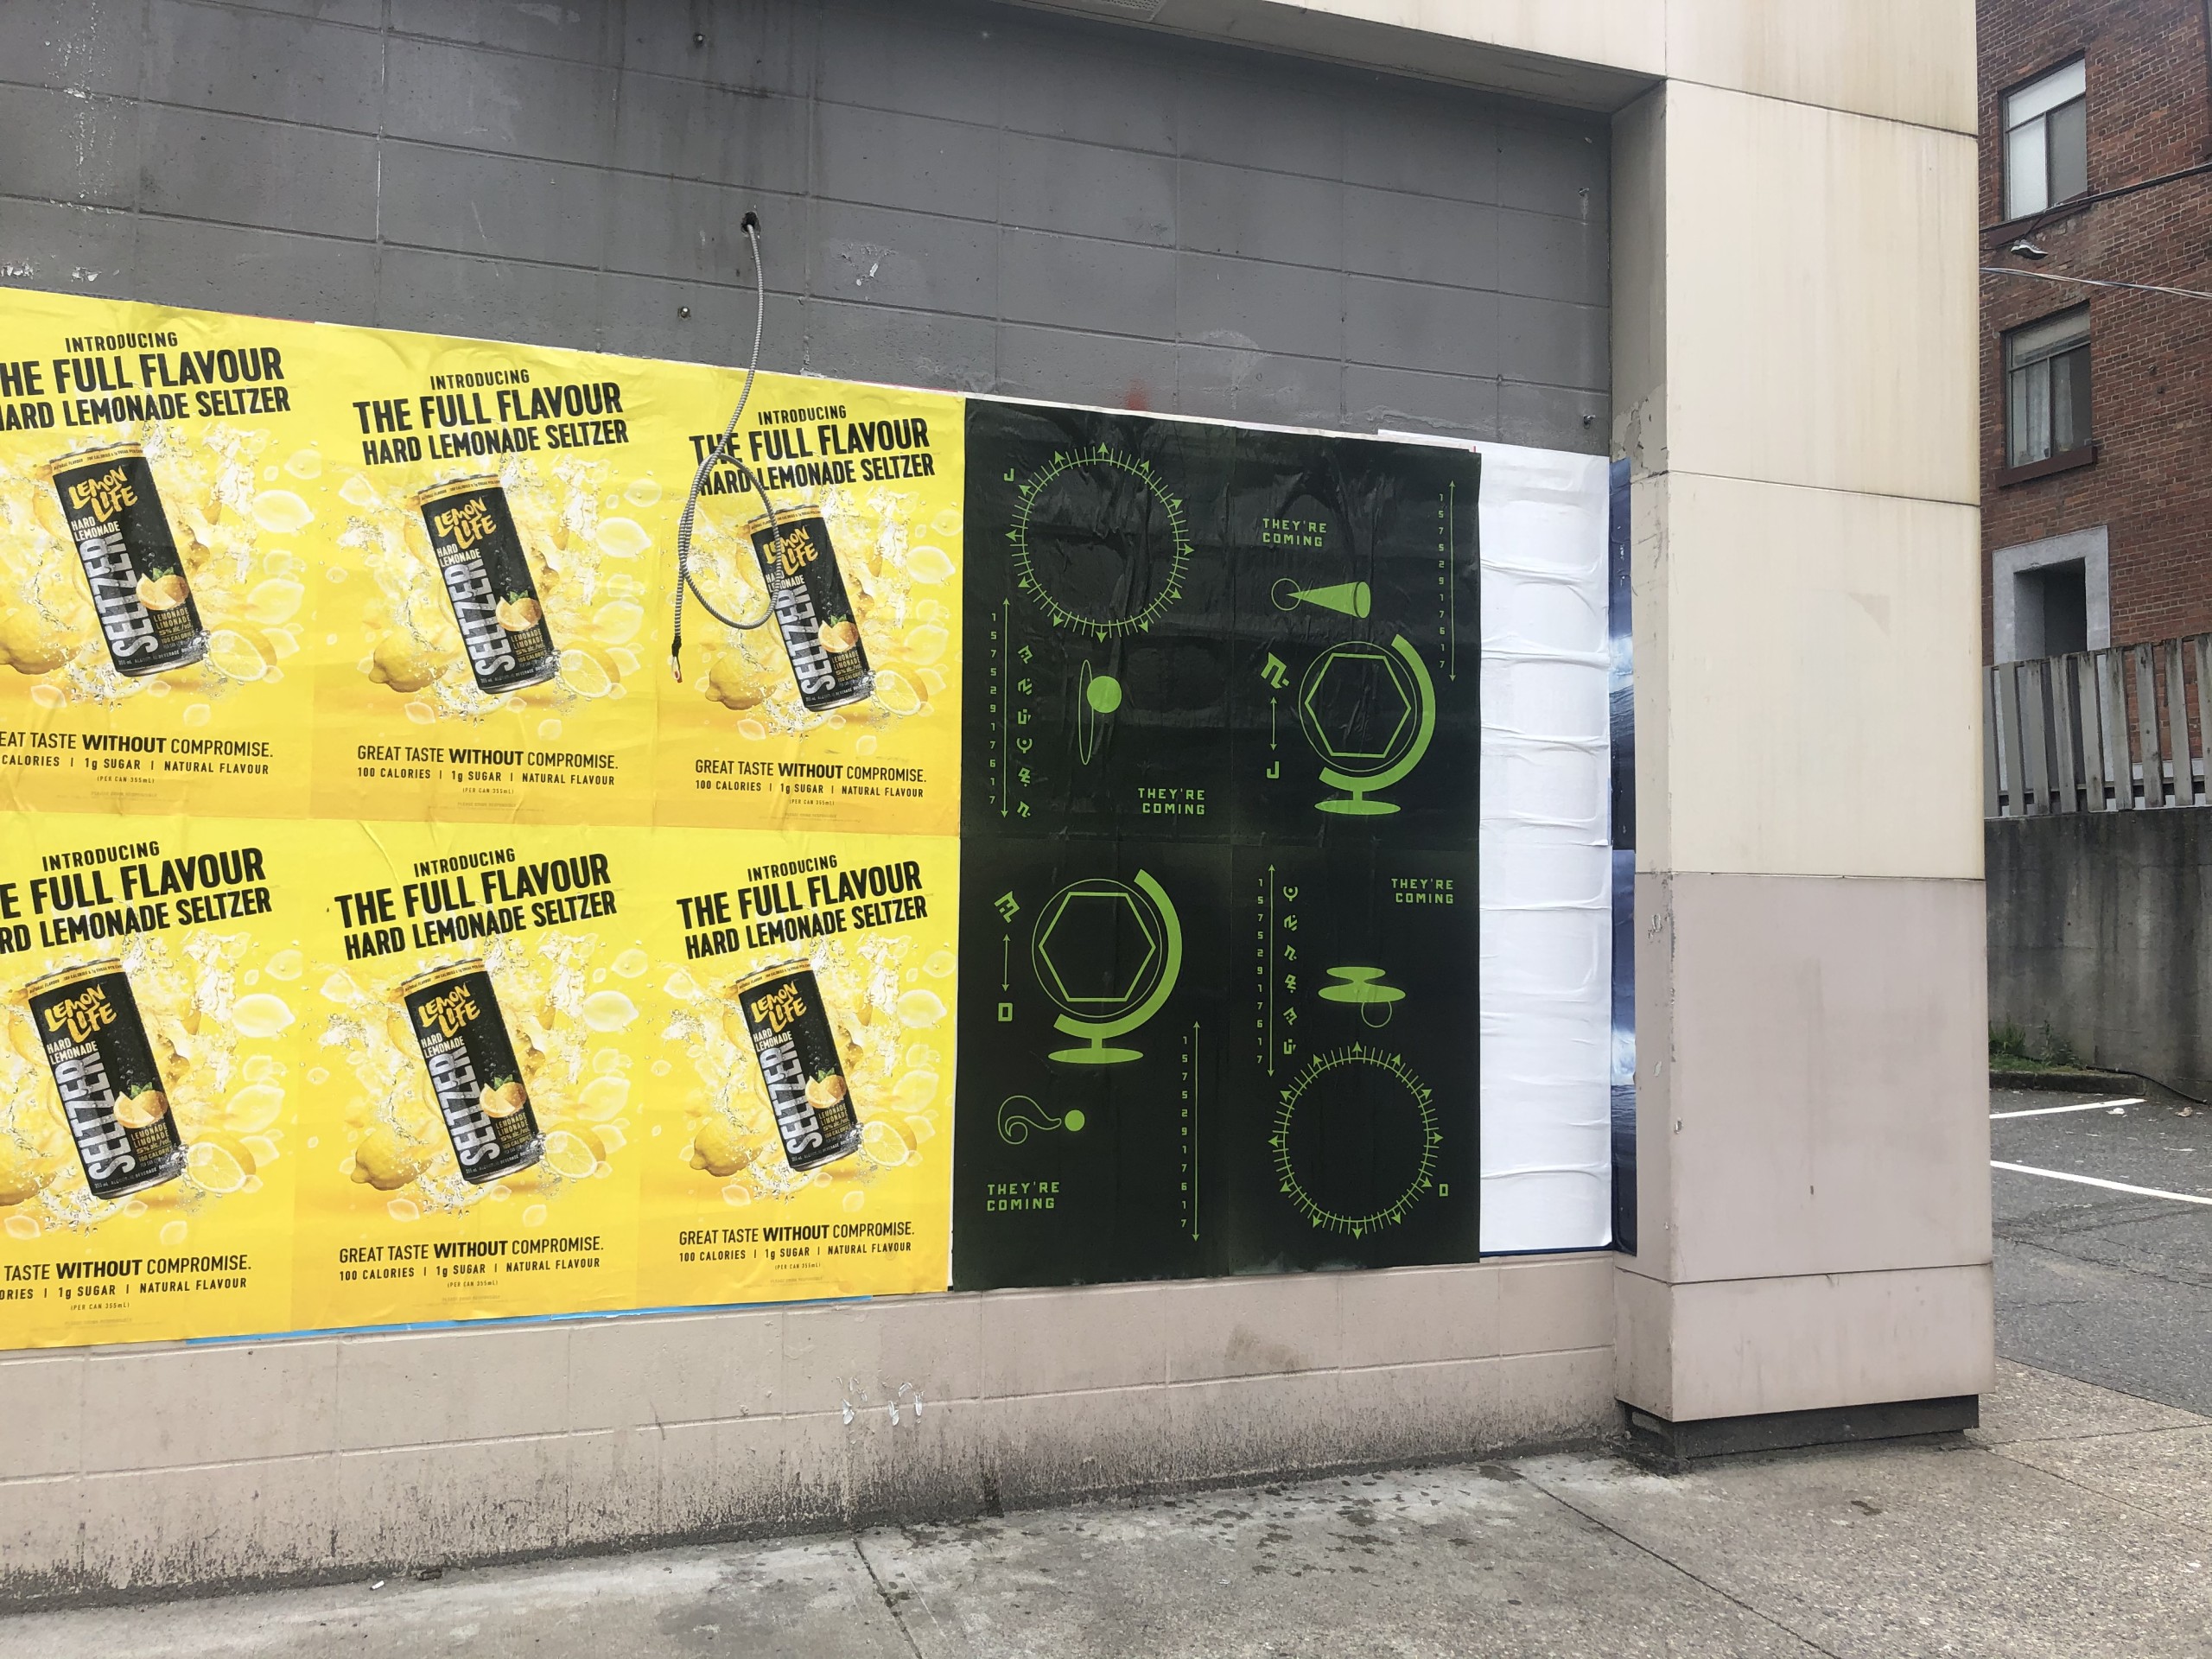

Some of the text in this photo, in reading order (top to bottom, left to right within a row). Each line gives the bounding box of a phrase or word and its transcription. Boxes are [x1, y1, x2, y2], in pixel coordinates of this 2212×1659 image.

[66, 332, 178, 353] INTRODUCING
[0, 347, 284, 397] HE FULL FLAVOUR
[430, 369, 529, 390] INTRODUCING
[62, 393, 189, 426] LEMONADE
[195, 386, 290, 416] SELTZER
[353, 383, 623, 434] THE FULL FLAVOUR
[759, 405, 846, 425] INTRODUCING
[363, 420, 628, 465] HARD LEMONADE SELTZER
[689, 418, 930, 465] THE FULL FLAVOUR
[757, 461, 856, 491] LEMONADE
[861, 454, 935, 481] SELTZER
[68, 465, 127, 509] LEMON
[92, 483, 137, 522] LIFE
[71, 517, 95, 531] HARD
[435, 497, 486, 537] LEMON
[1263, 518, 1326, 533] THEY'RE
[74, 521, 120, 542] LEMONADE
[454, 513, 496, 549] LIFE
[1263, 532, 1322, 547] COMING
[436, 543, 458, 557] HARD
[439, 549, 481, 568] LEMONADE
[782, 540, 817, 575] LIFE
[79, 532, 158, 657] SELTZER
[445, 559, 515, 675] SELTZER
[775, 585, 836, 694] SELTZER
[30, 733, 76, 749] TASTE
[82, 734, 167, 753] WITHOUT
[171, 739, 272, 757] COMPROMISE.
[358, 746, 618, 768] GREAT TASTE WITHOUT COMPROMISE.
[3, 755, 268, 774] CALORIES 1g SUGAR NATURAL FLAVOUR
[359, 767, 613, 785] 100 CALORIES 1g SUGAR NATURAL FLAVOUR
[696, 760, 926, 782] GREAT TASTE WITHOUT COMPROMISE.
[696, 780, 923, 797] 100 CALORIES 1g SUGAR NATURAL FLAVOUR
[1138, 788, 1205, 800] THEY'RE
[1142, 803, 1205, 815] COMING
[42, 842, 159, 871] INTRODUCING
[414, 849, 515, 877] INTRODUCING
[747, 855, 837, 881] INTRODUCING
[30, 871, 113, 914] FULL
[120, 848, 265, 900] FLAVOUR
[334, 854, 611, 928] THE FULL FLAVOUR
[1391, 879, 1452, 889] THEY'RE
[677, 861, 922, 929] THE FULL FLAVOUR
[1395, 893, 1453, 904] COMING
[40, 902, 170, 947] LEMONADE
[176, 887, 272, 925] SELTZER
[345, 891, 617, 960] HARD LEMONADE SELTZER
[685, 896, 927, 959] HARD LEMONADE SELTZER
[44, 984, 105, 1032] LEMON
[418, 982, 471, 1028] LEMON
[751, 981, 798, 1023] LEMON
[769, 997, 806, 1033] LIFE
[67, 1002, 117, 1043] LIFE
[438, 1001, 480, 1038] LIFE
[47, 1038, 71, 1053] HARD
[421, 1033, 442, 1048] HARD
[423, 1036, 465, 1058] LEMONADE
[753, 1028, 772, 1042] HARD
[755, 1031, 792, 1052] LEMONADE
[49, 1040, 98, 1065] LEMONADE
[429, 1046, 500, 1166] SELTZER
[760, 1040, 823, 1154] SELTZER
[55, 1052, 136, 1179] SELTZER
[131, 1123, 167, 1141] LEMONADE
[134, 1130, 169, 1148] LIMONADE
[987, 1181, 1059, 1195] THEY'RE
[987, 1198, 1054, 1211] COMING
[680, 1222, 914, 1245] GREAT TASTE WITHOUT COMPROMISE.
[340, 1236, 603, 1263] GREAT TASTE WITHOUT COMPROMISE.
[680, 1243, 911, 1262] 100 CALORIES 1g SUGAR NATURAL FLAVOUR
[4, 1255, 251, 1281] TASTE WITHOUT COMPROMISE.
[340, 1258, 599, 1281] 100 CALORIES 1g SUGAR NATURAL FLAVOUR
[59, 1287, 71, 1300] 1g
[78, 1285, 115, 1296] SUGAR
[140, 1281, 189, 1293] NATURAL
[196, 1278, 246, 1290] FLAVOUR
